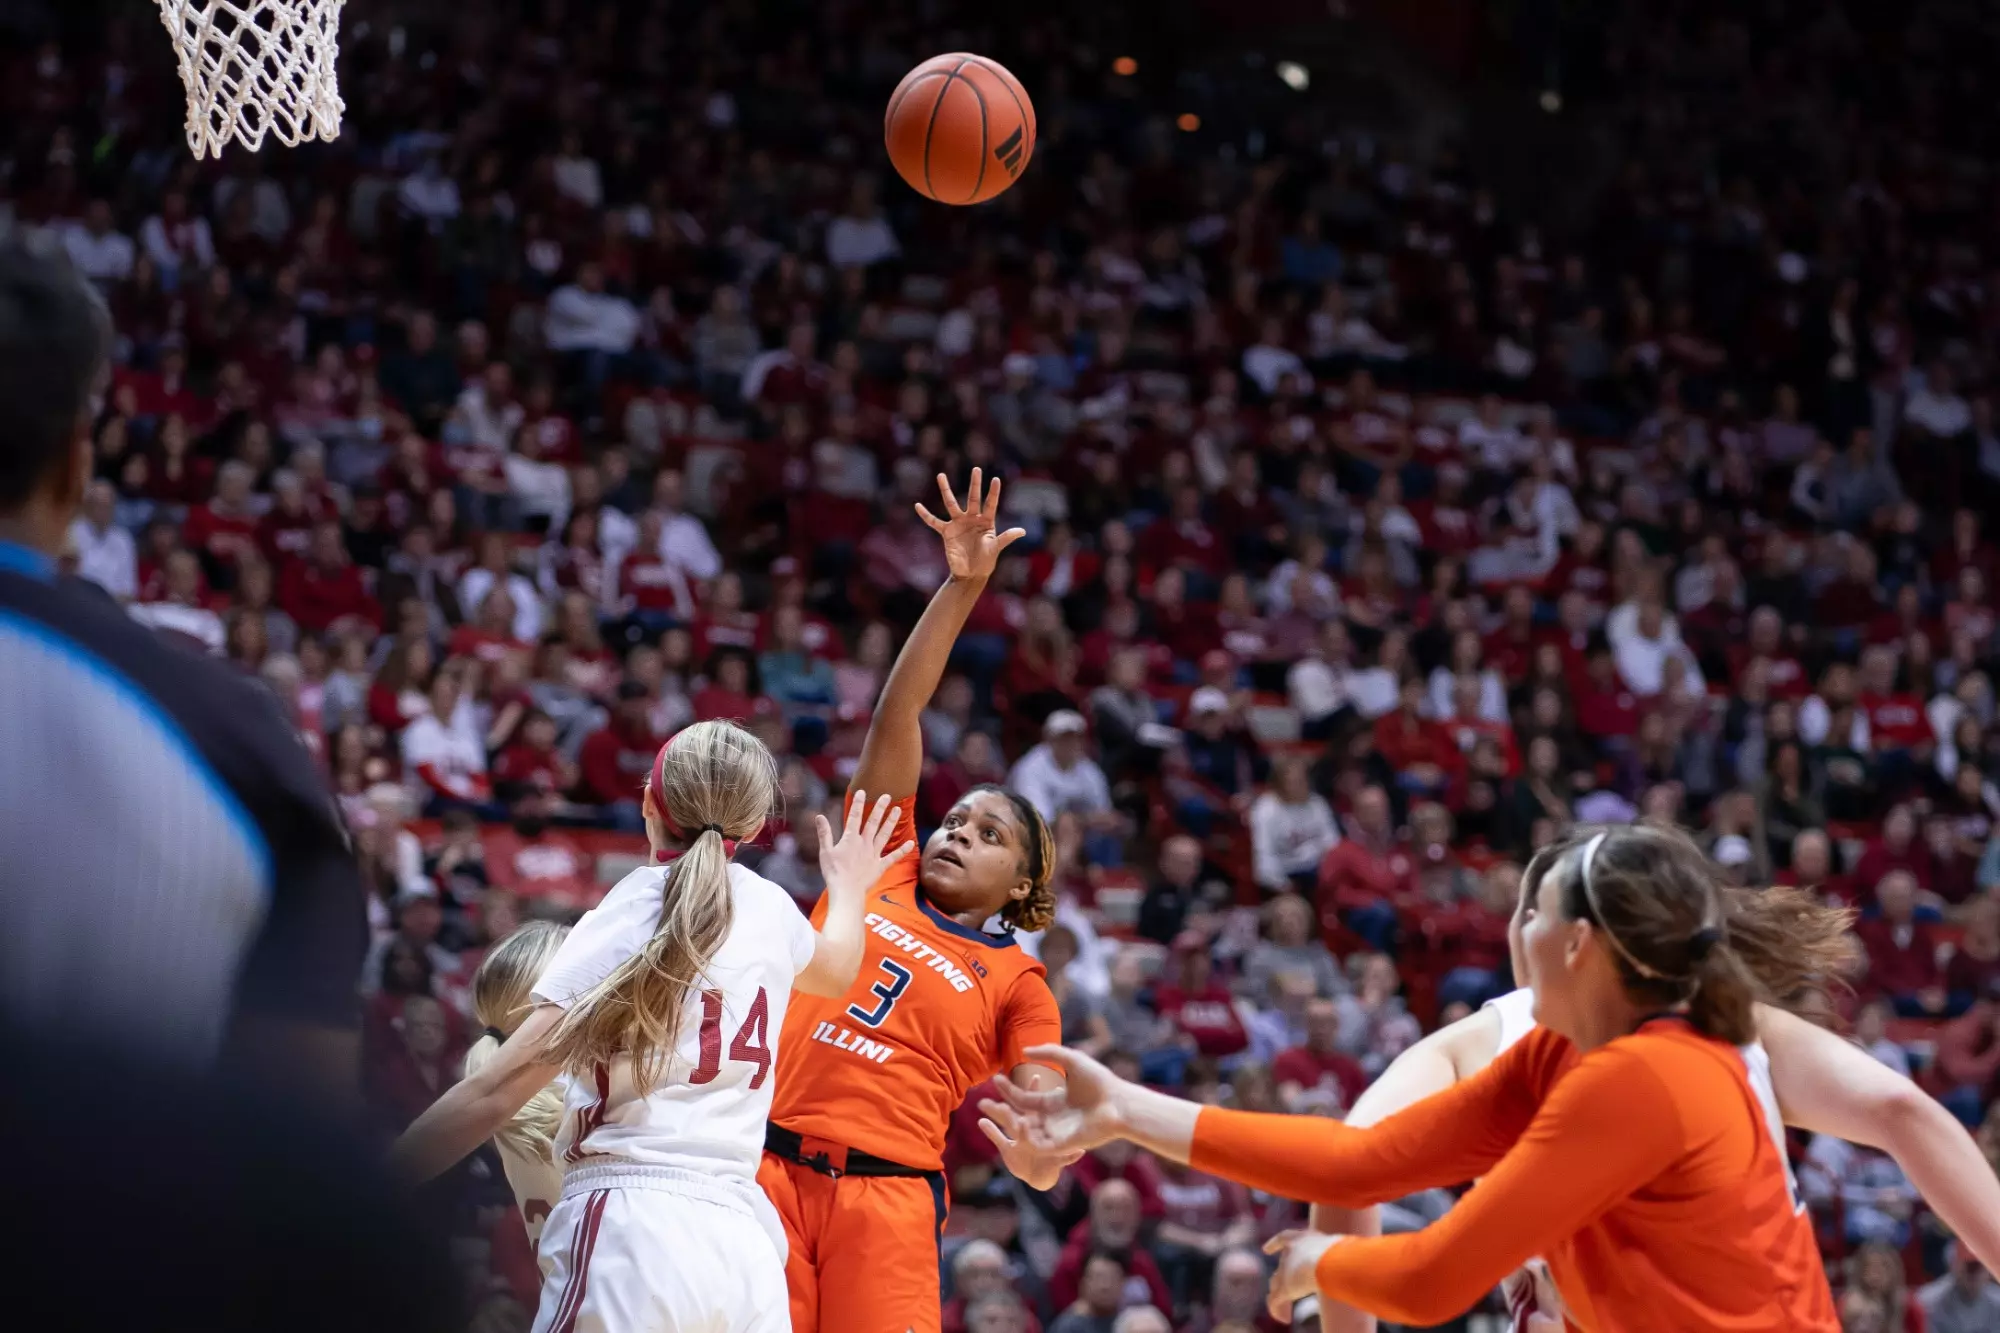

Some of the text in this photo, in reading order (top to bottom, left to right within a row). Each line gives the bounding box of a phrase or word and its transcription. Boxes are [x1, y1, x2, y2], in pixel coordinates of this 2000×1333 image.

[864, 912, 974, 993] FIGHTING
[846, 956, 914, 1029] 3
[688, 985, 772, 1090] 14
[812, 1021, 894, 1064] ILLINI
